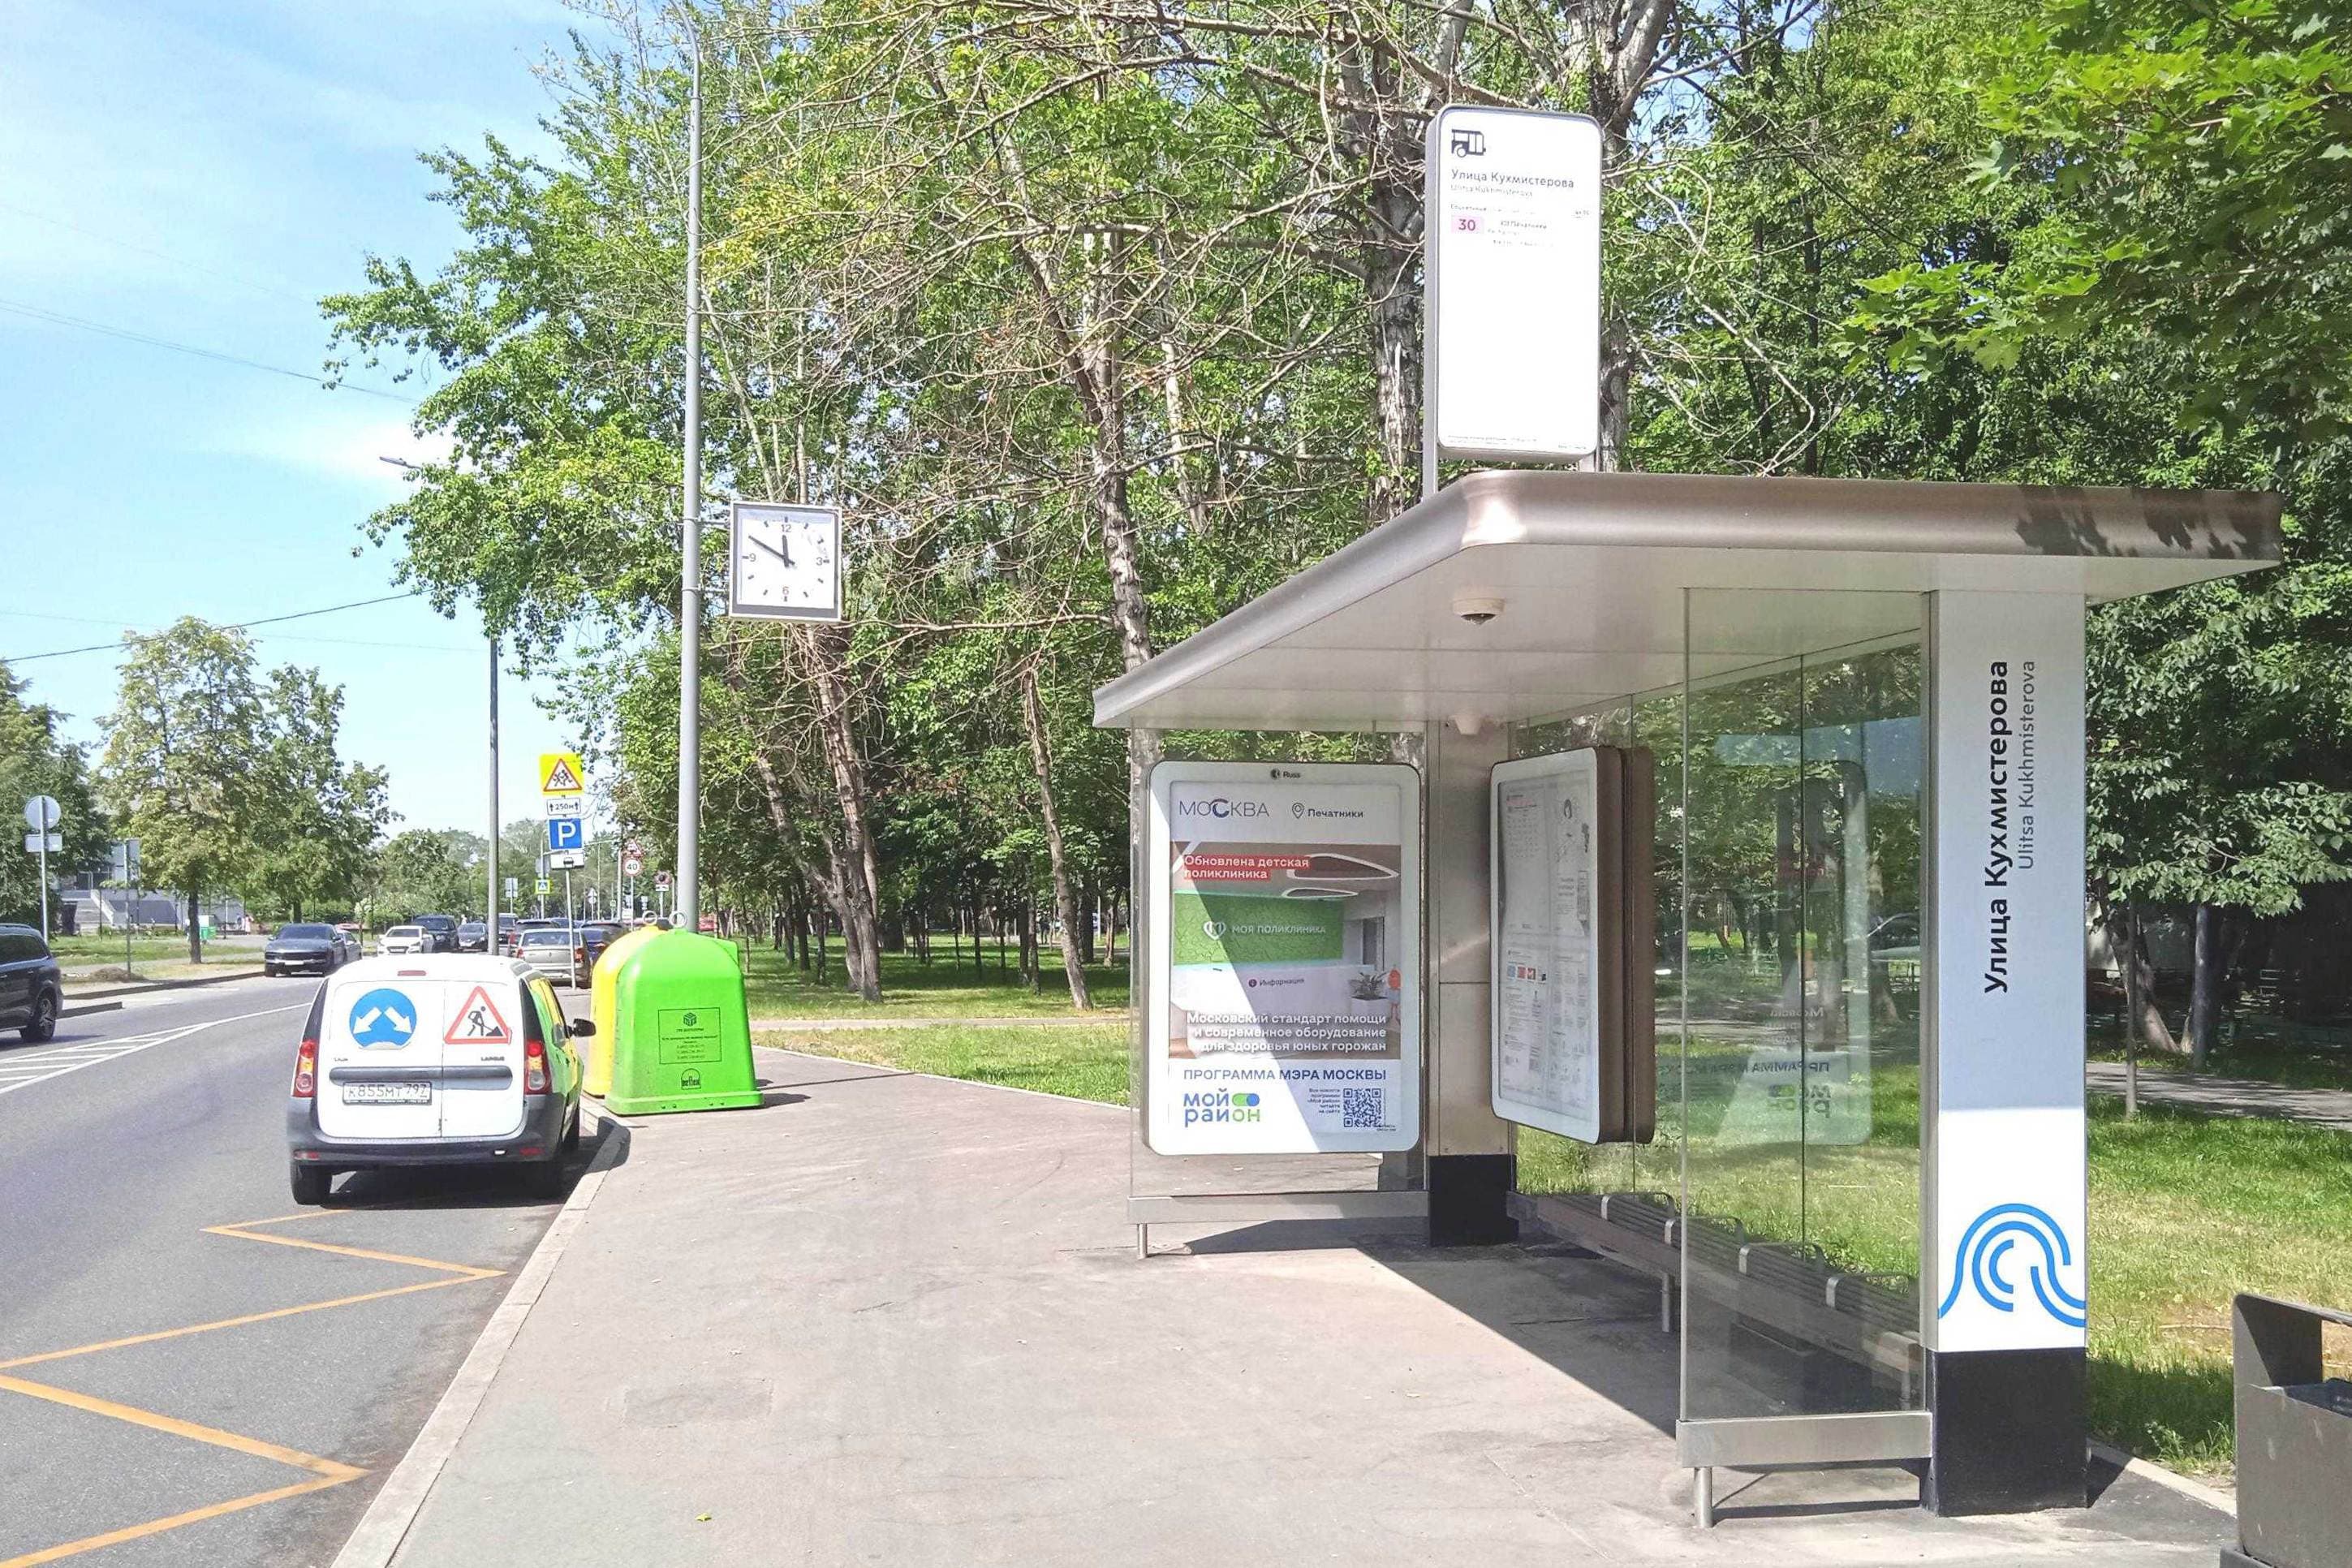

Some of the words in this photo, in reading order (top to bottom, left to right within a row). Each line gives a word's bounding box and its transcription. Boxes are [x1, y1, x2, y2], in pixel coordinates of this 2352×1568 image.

[1451, 169, 1487, 182] Улица
[1492, 172, 1574, 188] Кухмистерова
[1458, 218, 1476, 231] 30
[781, 523, 792, 533] 12
[749, 553, 756, 562] 9
[816, 557, 823, 566] 3
[782, 586, 790, 596] 6
[2018, 661, 2035, 808] Kukhmisterova
[1282, 771, 1301, 779] Russ
[1984, 661, 2013, 887] Кухмистерова
[1179, 798, 1270, 818] МОСКВА
[1307, 808, 1363, 819] Печатники
[557, 821, 577, 846] P
[2018, 815, 2035, 870] Ulitsa
[626, 863, 638, 871] 40
[1184, 855, 1255, 868] Обновлена
[1257, 858, 1310, 870] детская
[1185, 869, 1268, 880] поликлиника
[1984, 898, 2011, 994] Улица
[1187, 1012, 1268, 1023] Московский
[1271, 1014, 1332, 1026] стандарт
[1334, 1014, 1386, 1025] помощи
[1195, 1028, 1203, 1037] и
[1204, 1028, 1292, 1040] современное
[1294, 1027, 1387, 1040] оборудование
[1200, 1042, 1225, 1053] для
[1228, 1042, 1290, 1053] здоровья
[1293, 1042, 1328, 1052] юных
[1331, 1042, 1387, 1053] горожан
[1183, 1070, 1275, 1080] ПРОГРАММА
[1279, 1070, 1320, 1080] МЭРА
[1323, 1070, 1386, 1080] МОСКВЫ
[1183, 1088, 1229, 1107] мой
